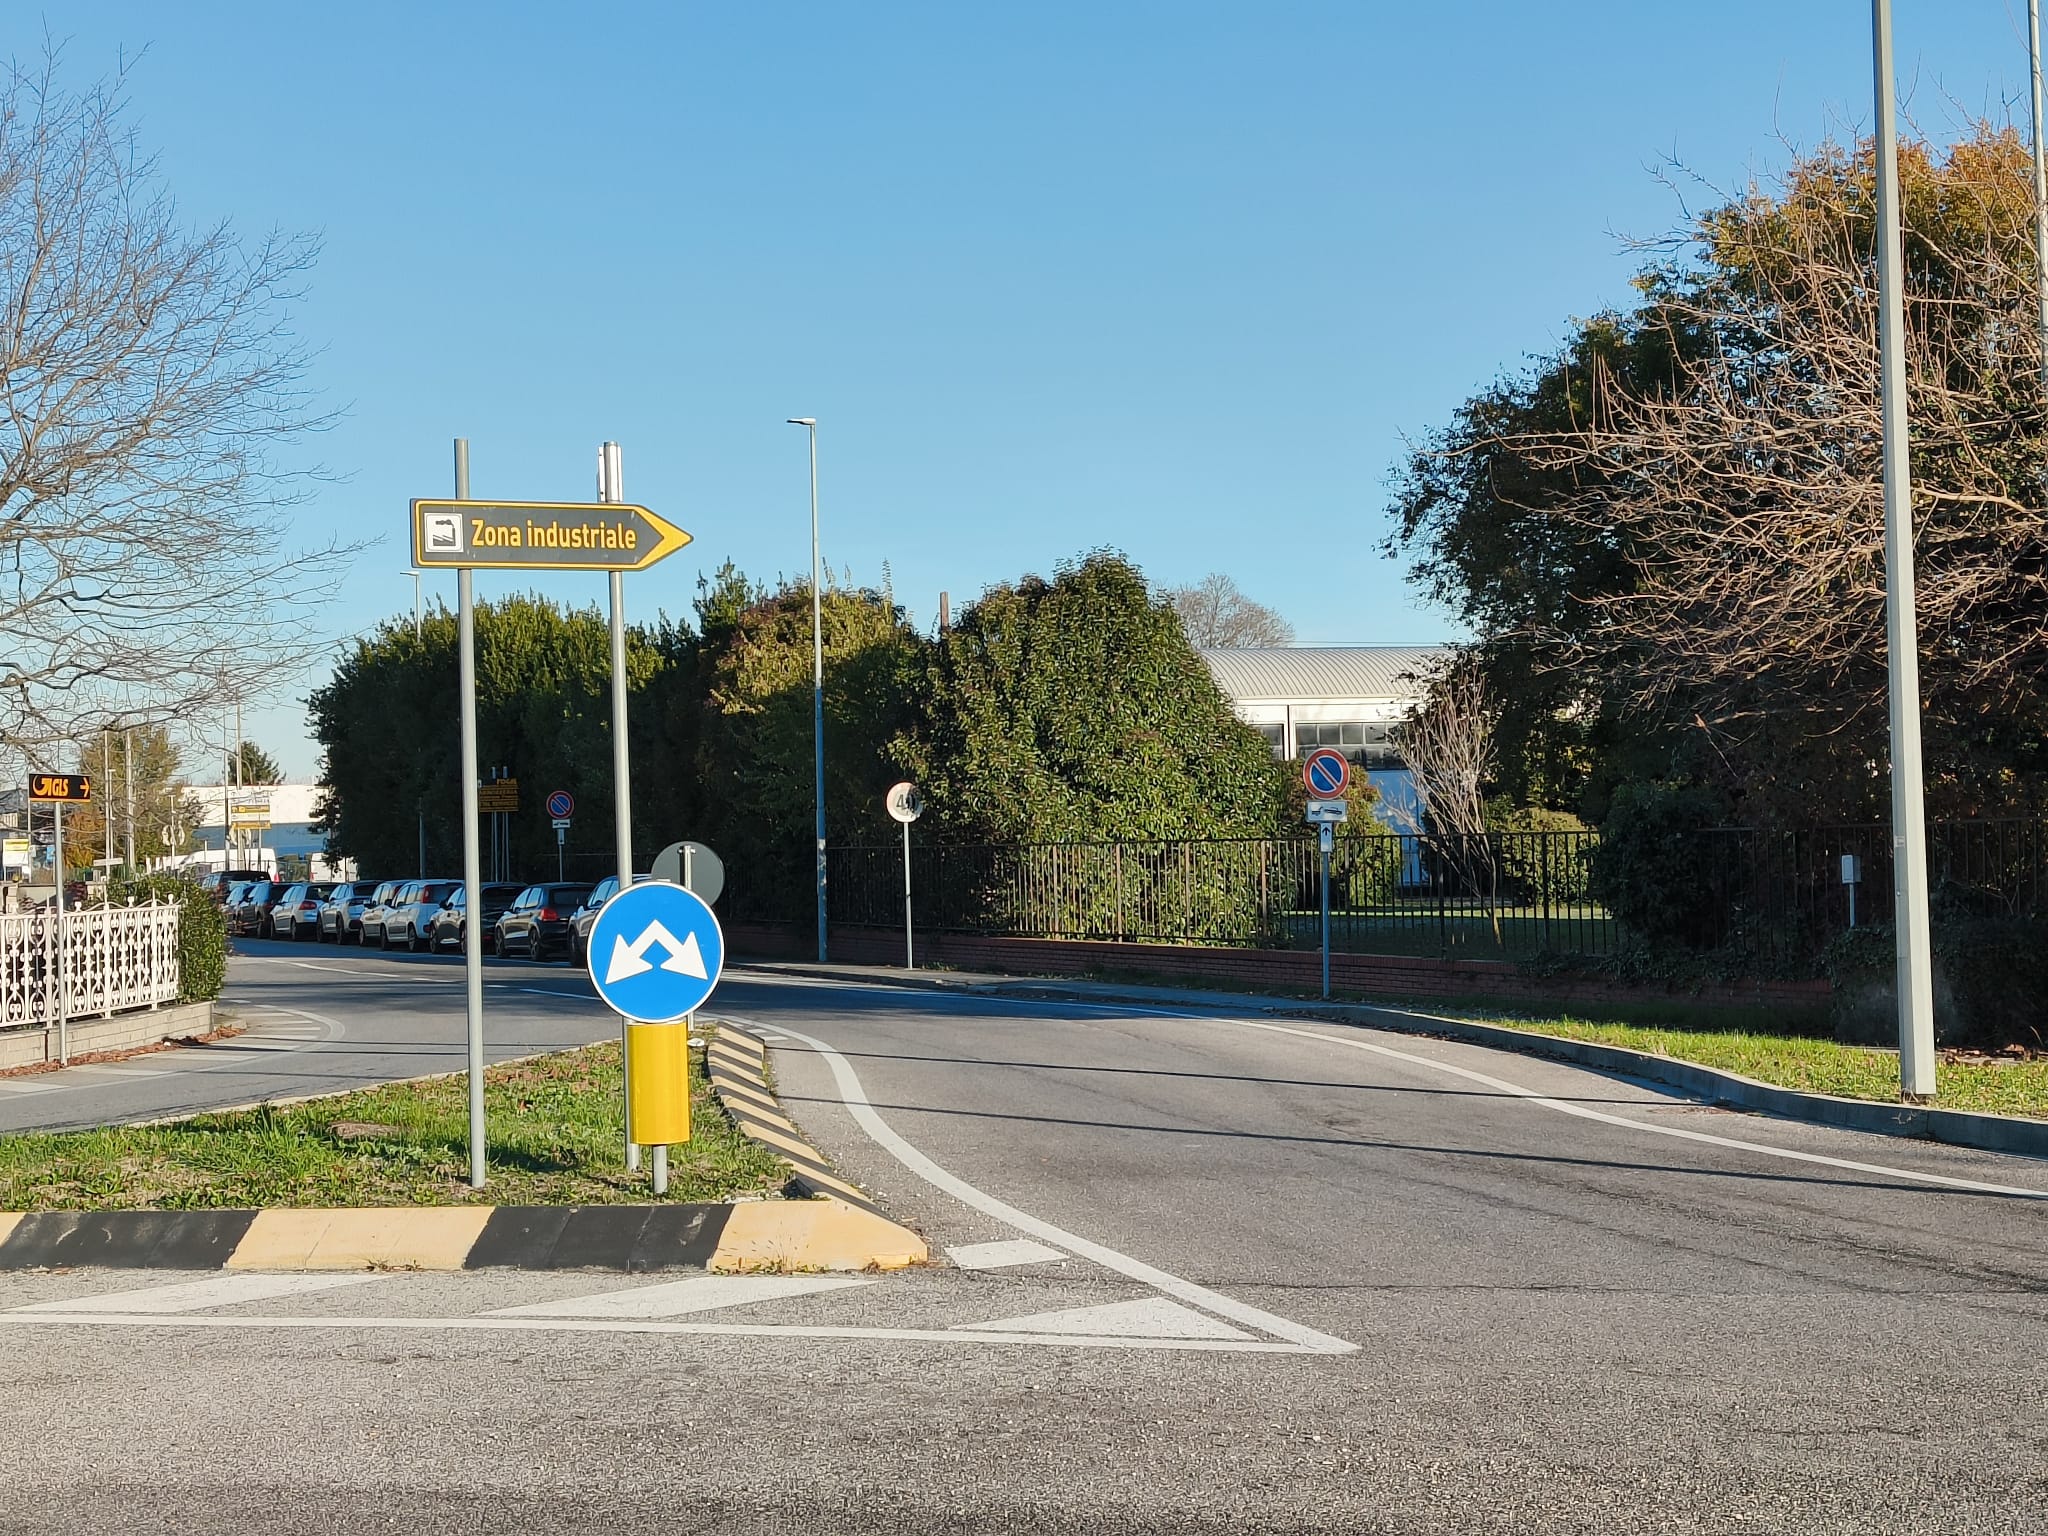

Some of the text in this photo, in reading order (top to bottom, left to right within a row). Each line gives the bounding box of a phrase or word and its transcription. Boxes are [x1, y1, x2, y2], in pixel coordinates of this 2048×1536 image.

[471, 519, 637, 549] Zona industriale
[52, 778, 69, 797] GLS
